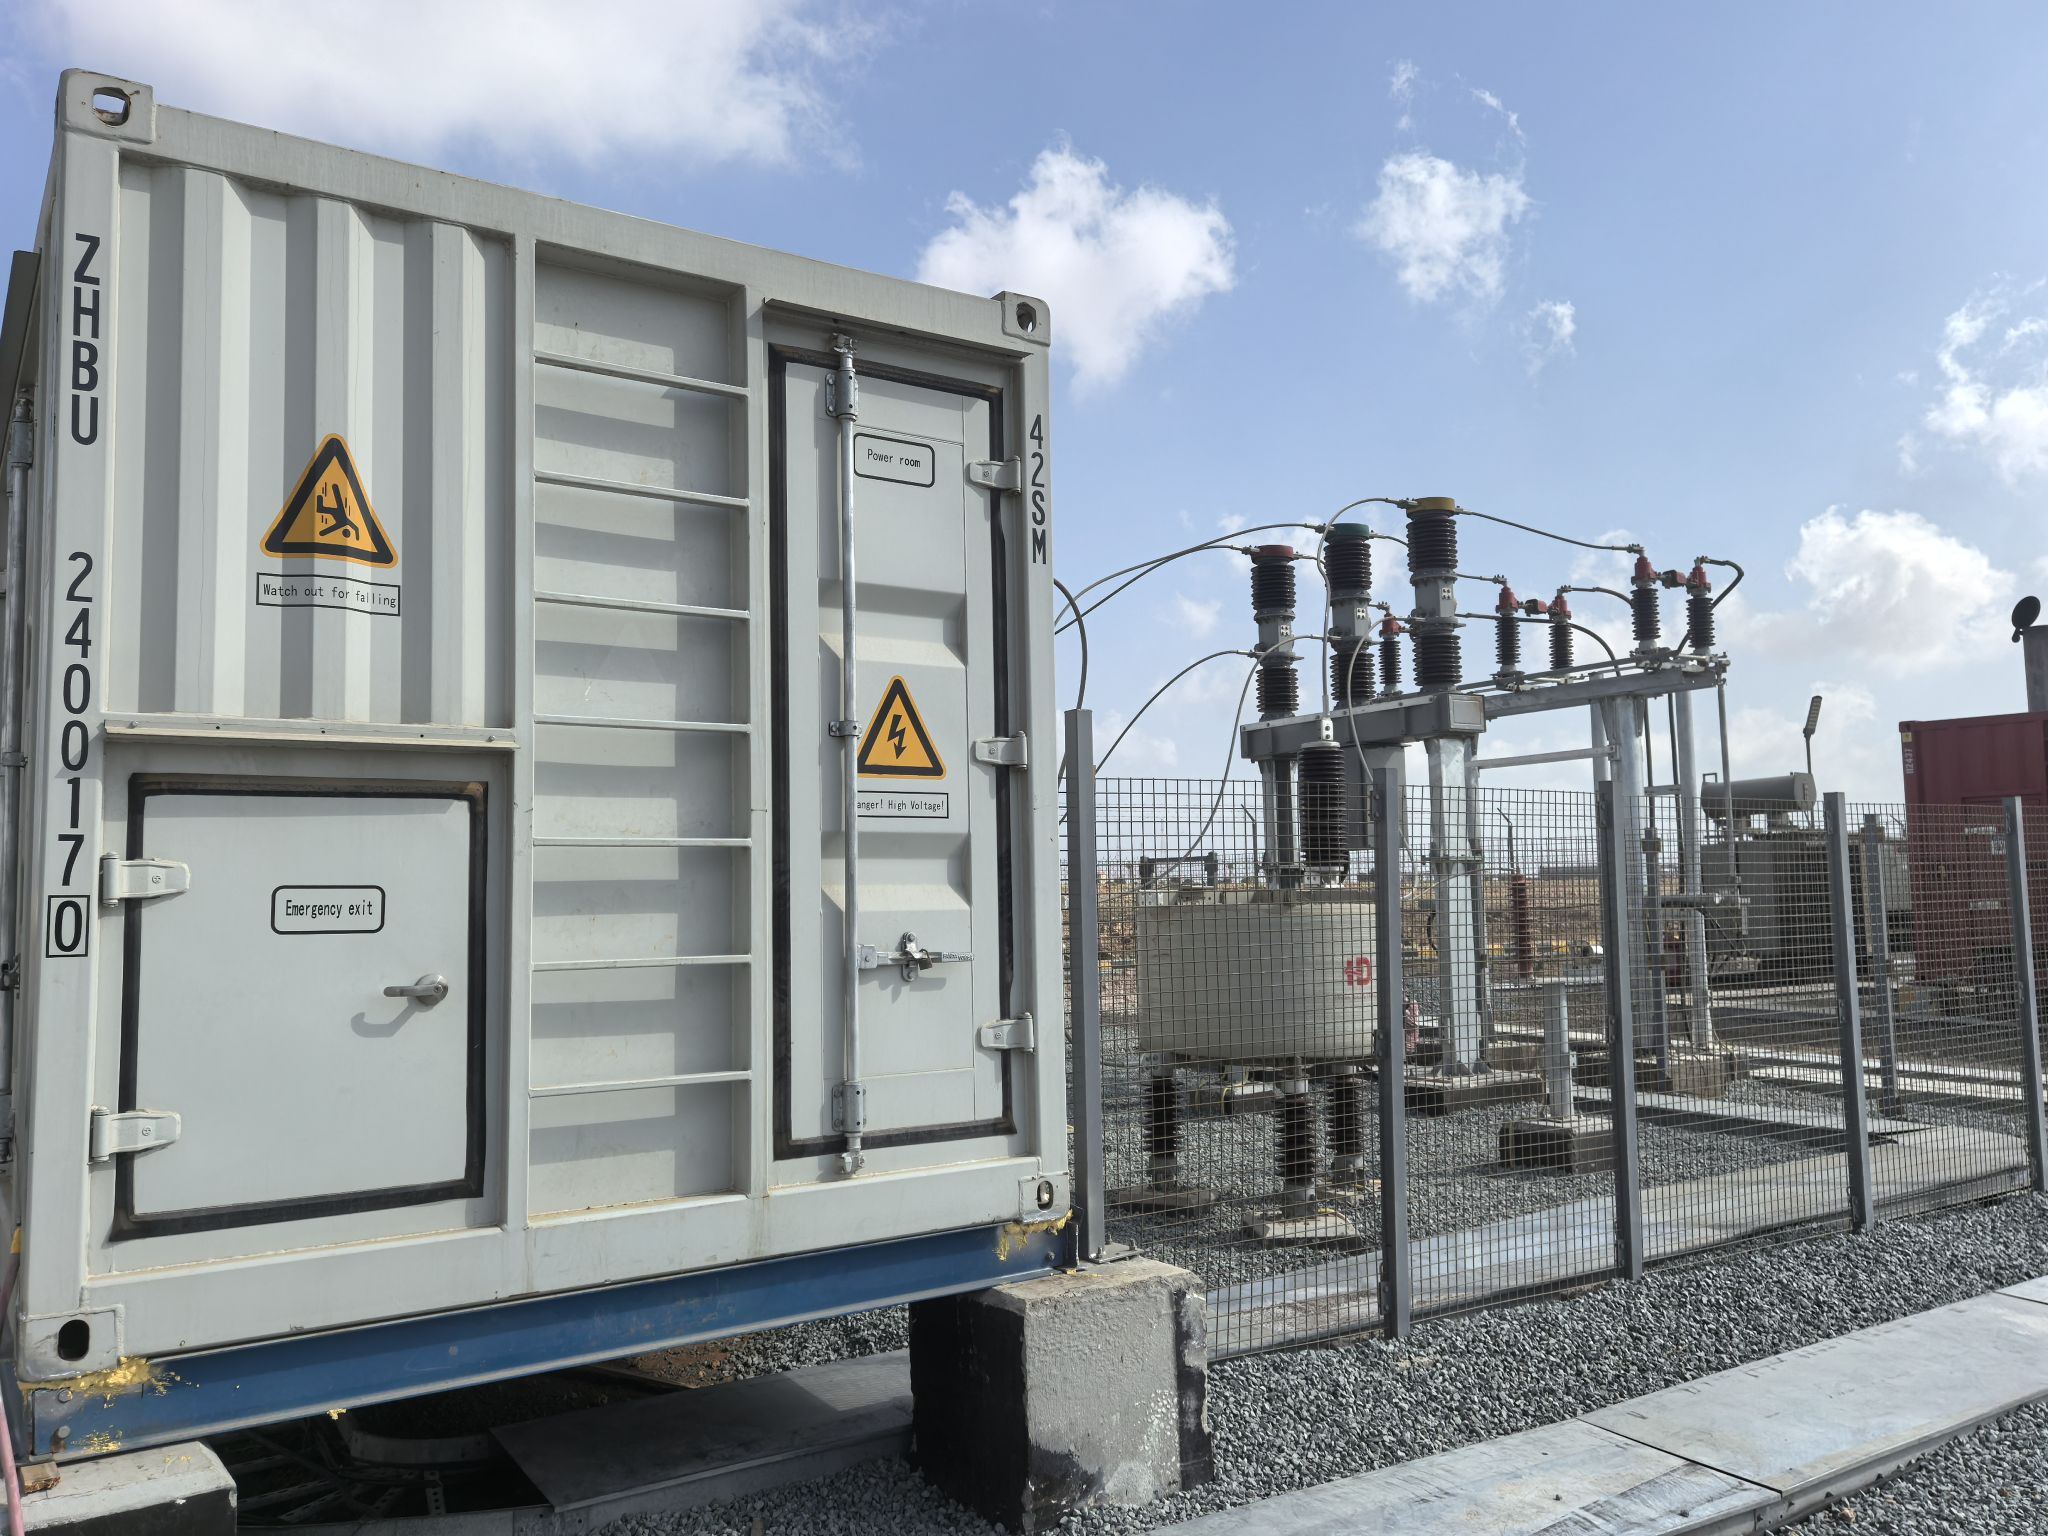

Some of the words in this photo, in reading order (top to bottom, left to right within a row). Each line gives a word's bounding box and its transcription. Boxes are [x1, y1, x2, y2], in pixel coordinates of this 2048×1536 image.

[72, 233, 100, 445] ZHBU
[867, 448, 894, 463] Power
[899, 457, 921, 468] room
[1030, 414, 1047, 565] 42SM
[263, 583, 298, 597] Watch
[304, 586, 324, 598] out
[332, 586, 350, 599] for
[356, 590, 397, 609] falling
[856, 798, 883, 811] anger!
[888, 799, 907, 811] High
[910, 800, 944, 812] Voltage!
[285, 899, 342, 919] Emergency
[348, 899, 373, 915] exit
